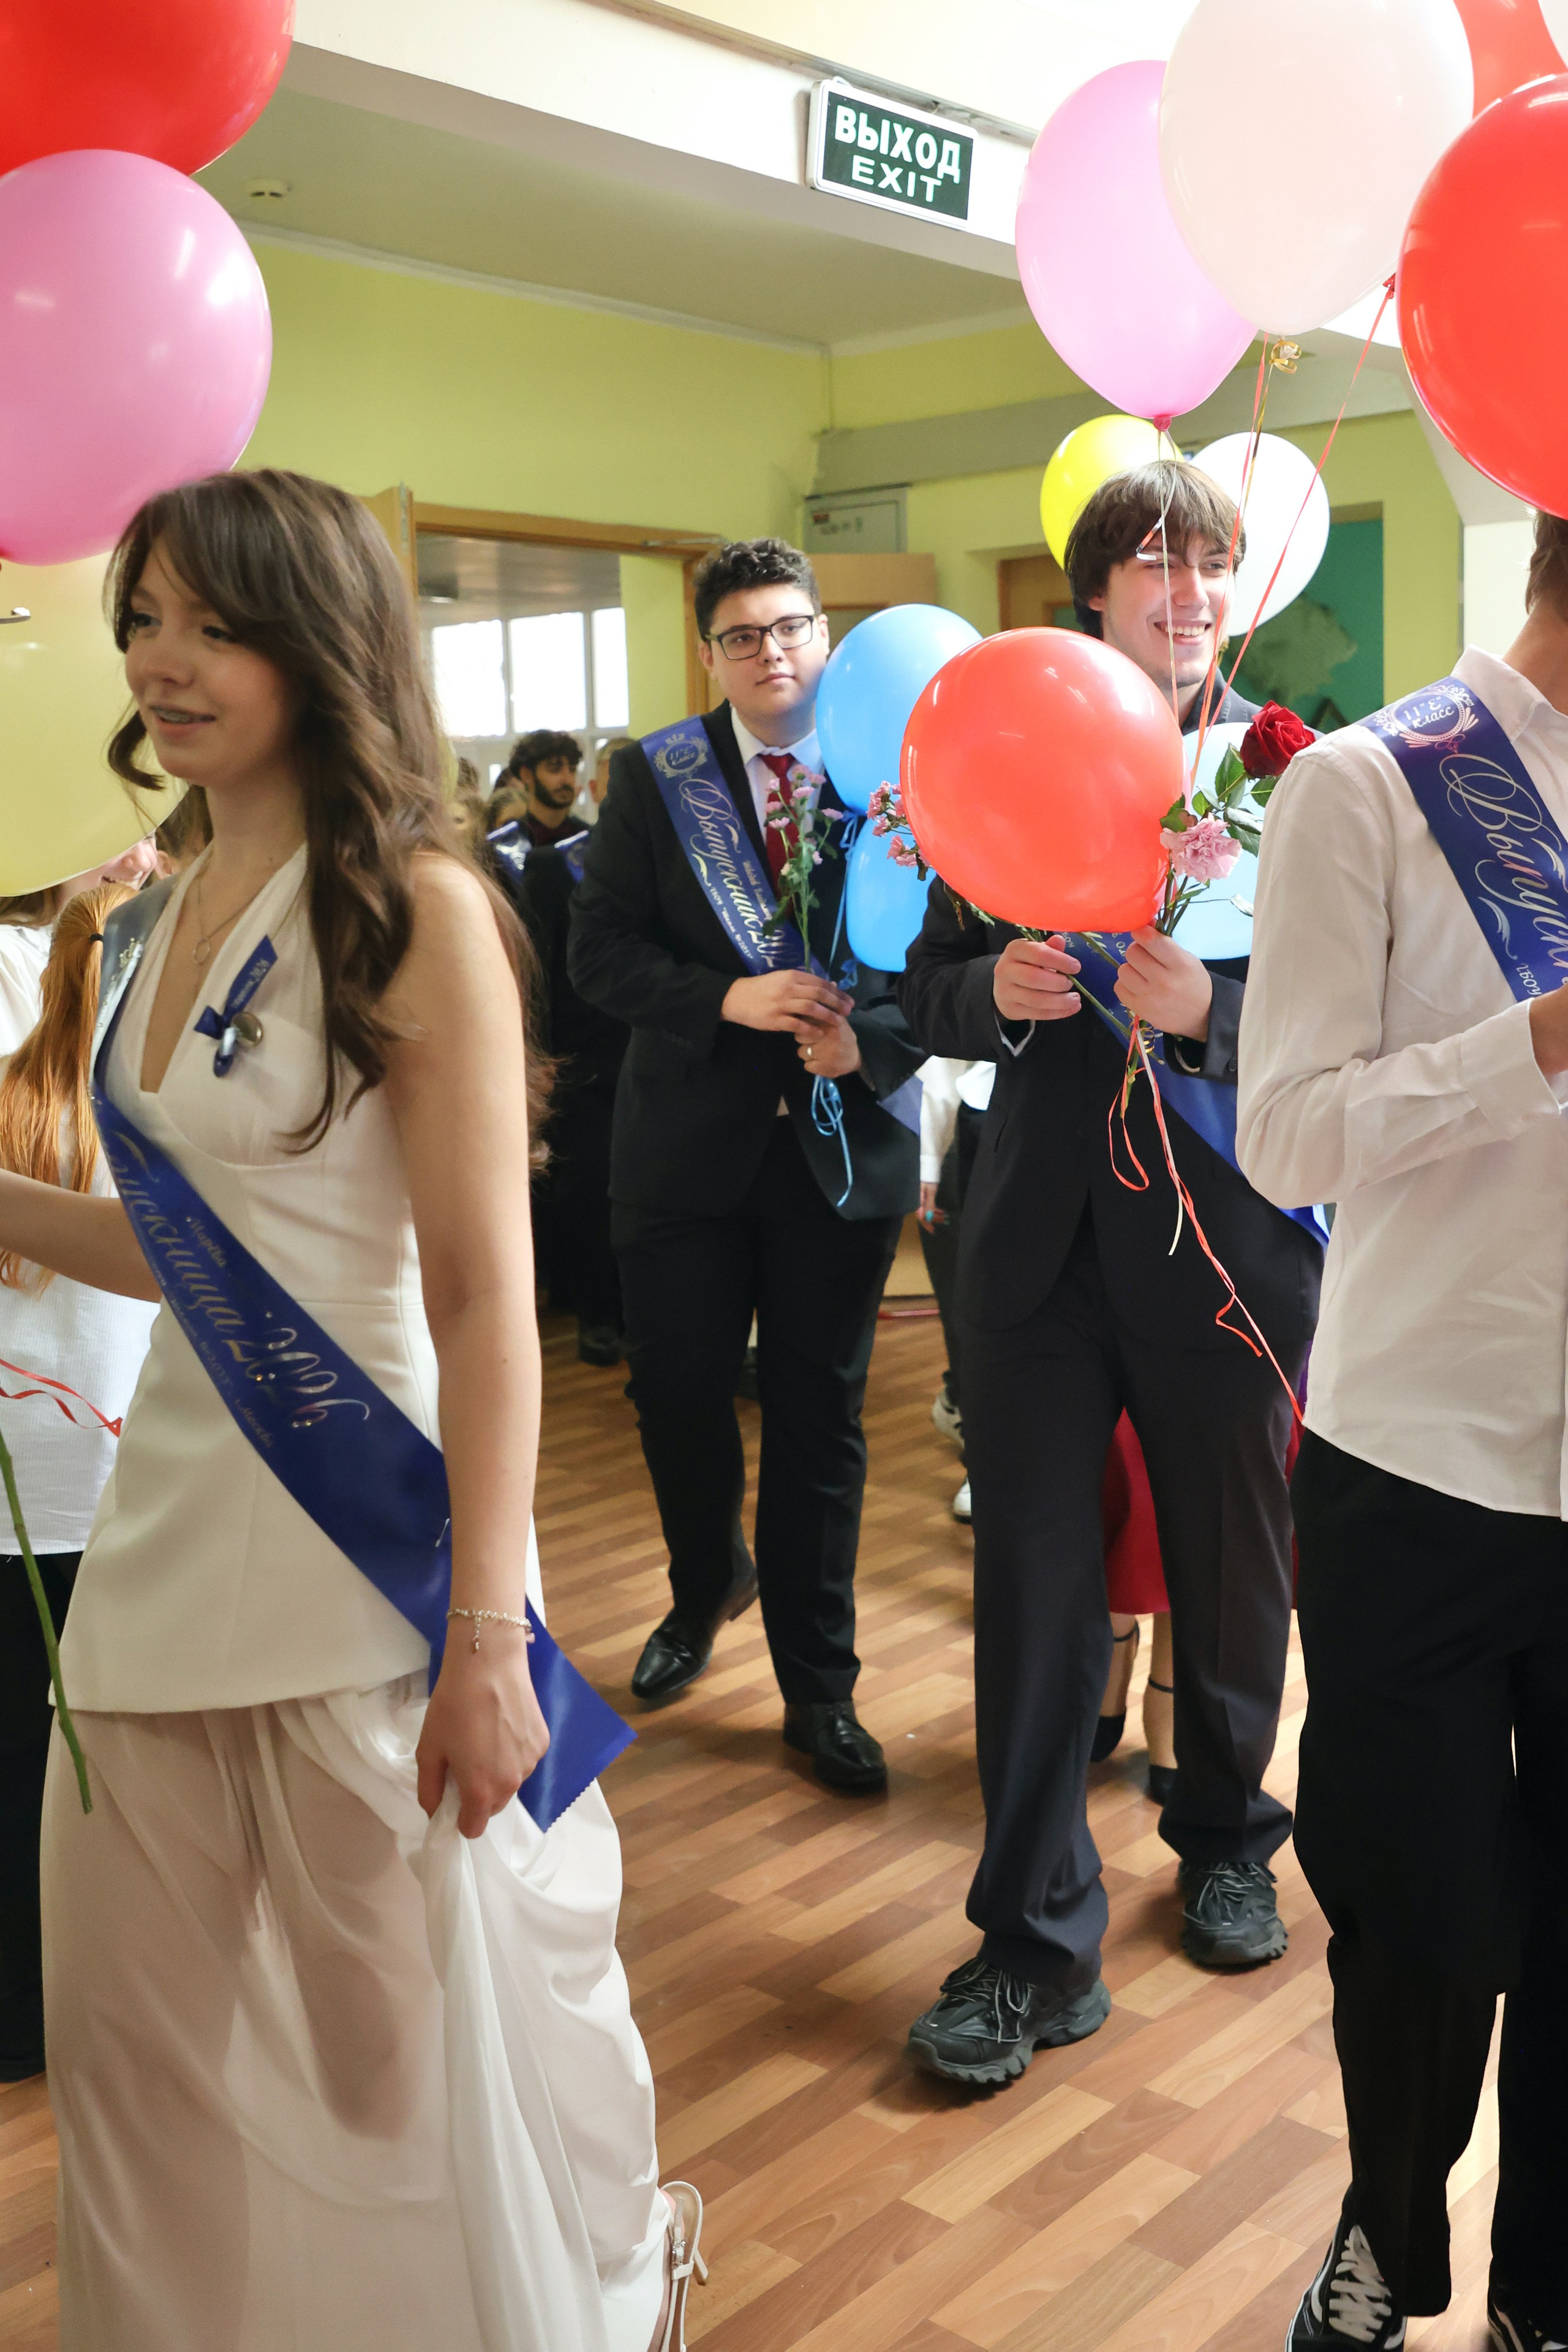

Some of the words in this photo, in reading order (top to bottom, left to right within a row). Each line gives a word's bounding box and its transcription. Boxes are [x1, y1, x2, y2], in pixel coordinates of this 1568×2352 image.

[835, 105, 961, 184] ВЫХОД
[852, 154, 942, 203] EXIT
[1412, 706, 1455, 728] класс
[679, 778, 763, 929] Выпускник
[747, 929, 801, 968] 202
[1439, 753, 1568, 984] Выпуск
[221, 1327, 370, 1426] 2026
